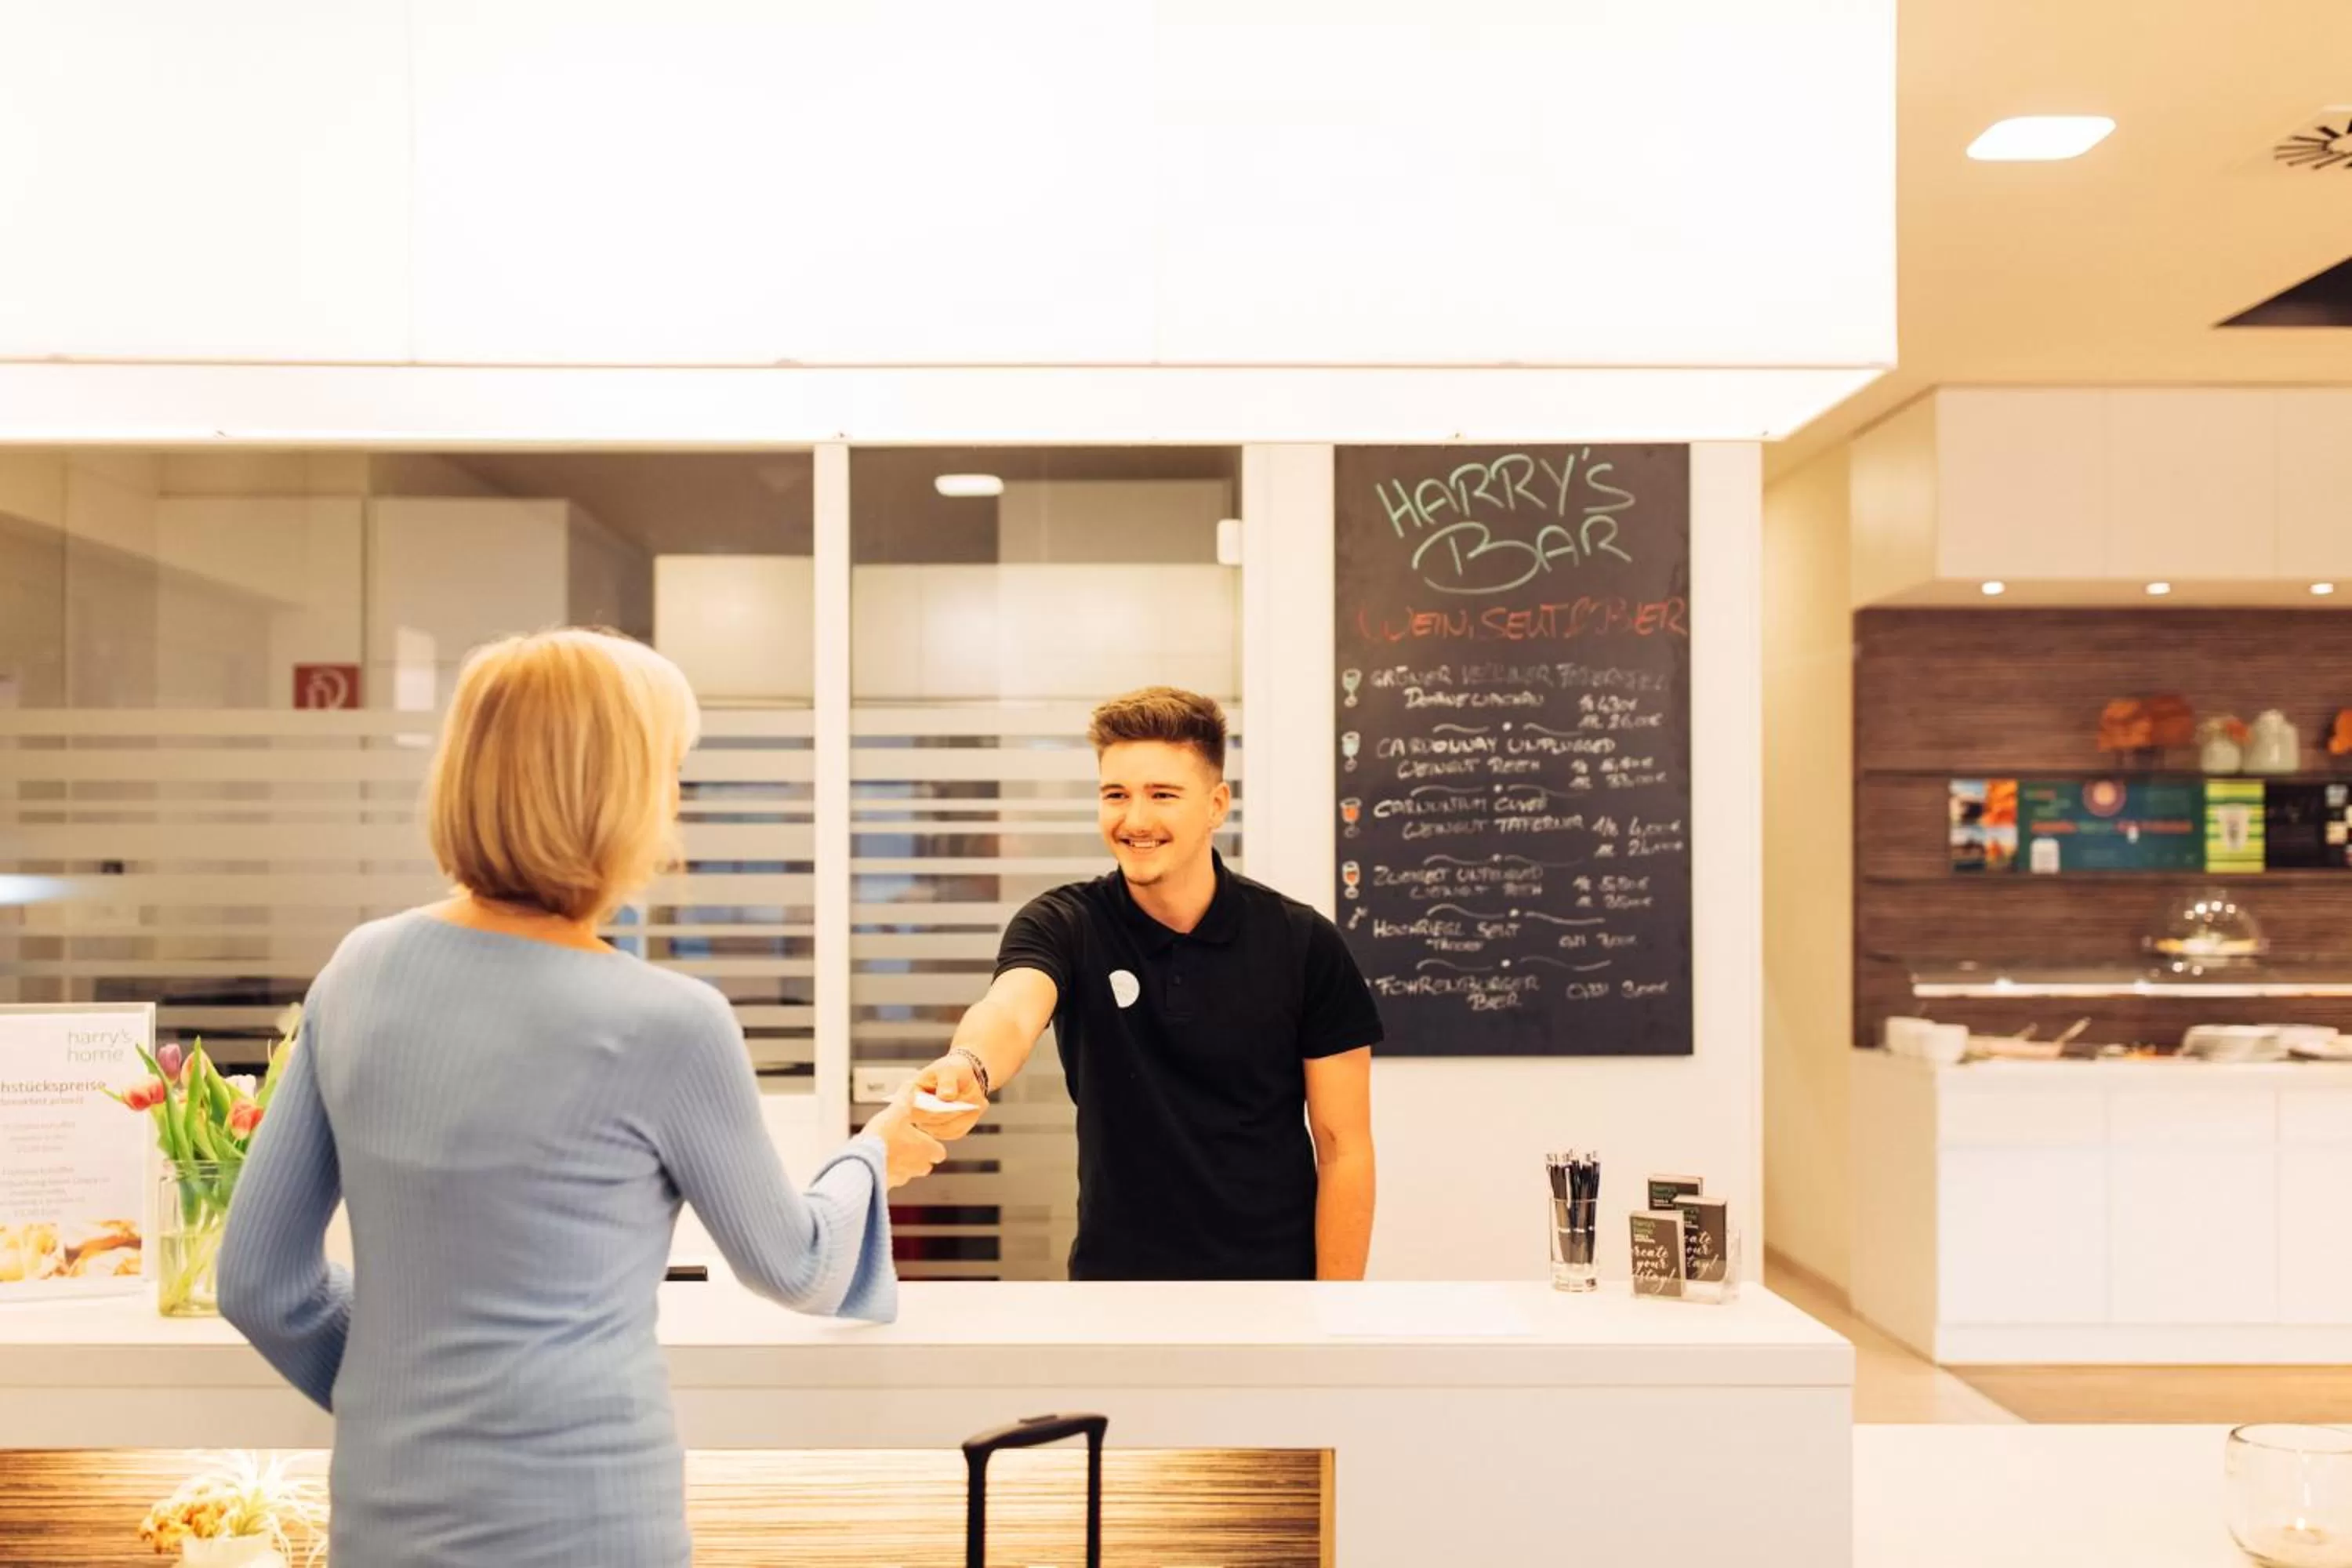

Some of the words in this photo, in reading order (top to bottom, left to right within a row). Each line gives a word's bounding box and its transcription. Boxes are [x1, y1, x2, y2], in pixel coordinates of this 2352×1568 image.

[1376, 447, 1636, 538] HARRY'S
[1412, 514, 1632, 594] BAR
[67, 1029, 132, 1047] harry's
[67, 1047, 124, 1064] home
